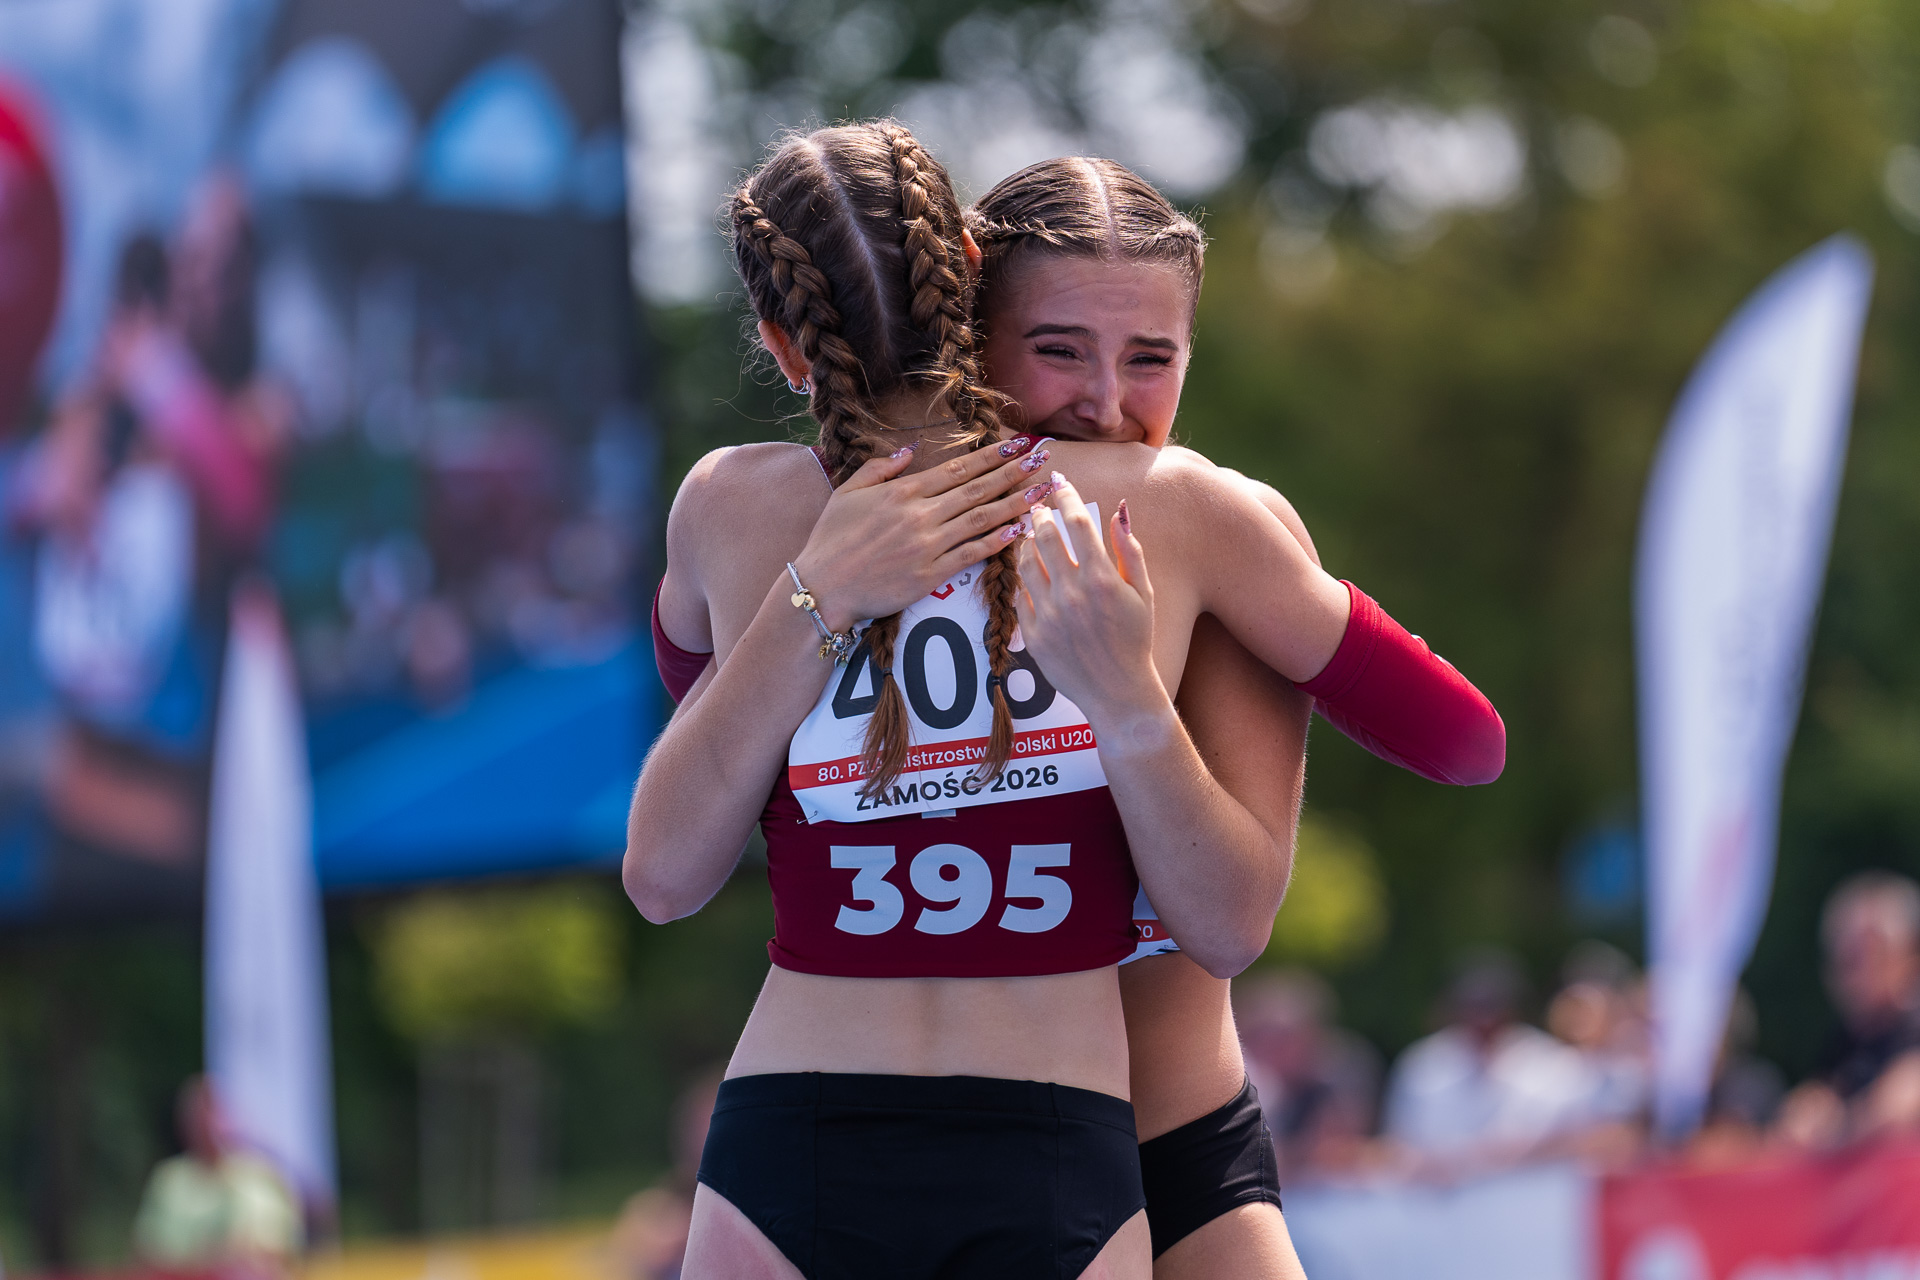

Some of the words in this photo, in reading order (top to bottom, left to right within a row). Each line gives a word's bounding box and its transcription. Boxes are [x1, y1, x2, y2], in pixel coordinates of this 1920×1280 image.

[832, 607, 1056, 730] 408
[818, 765, 844, 782] 80.
[903, 745, 987, 768] istrzostw
[1061, 729, 1093, 747] U20
[855, 768, 982, 811] ZAMOŚĆ
[991, 764, 1059, 793] 2026
[830, 843, 1073, 935] 395
